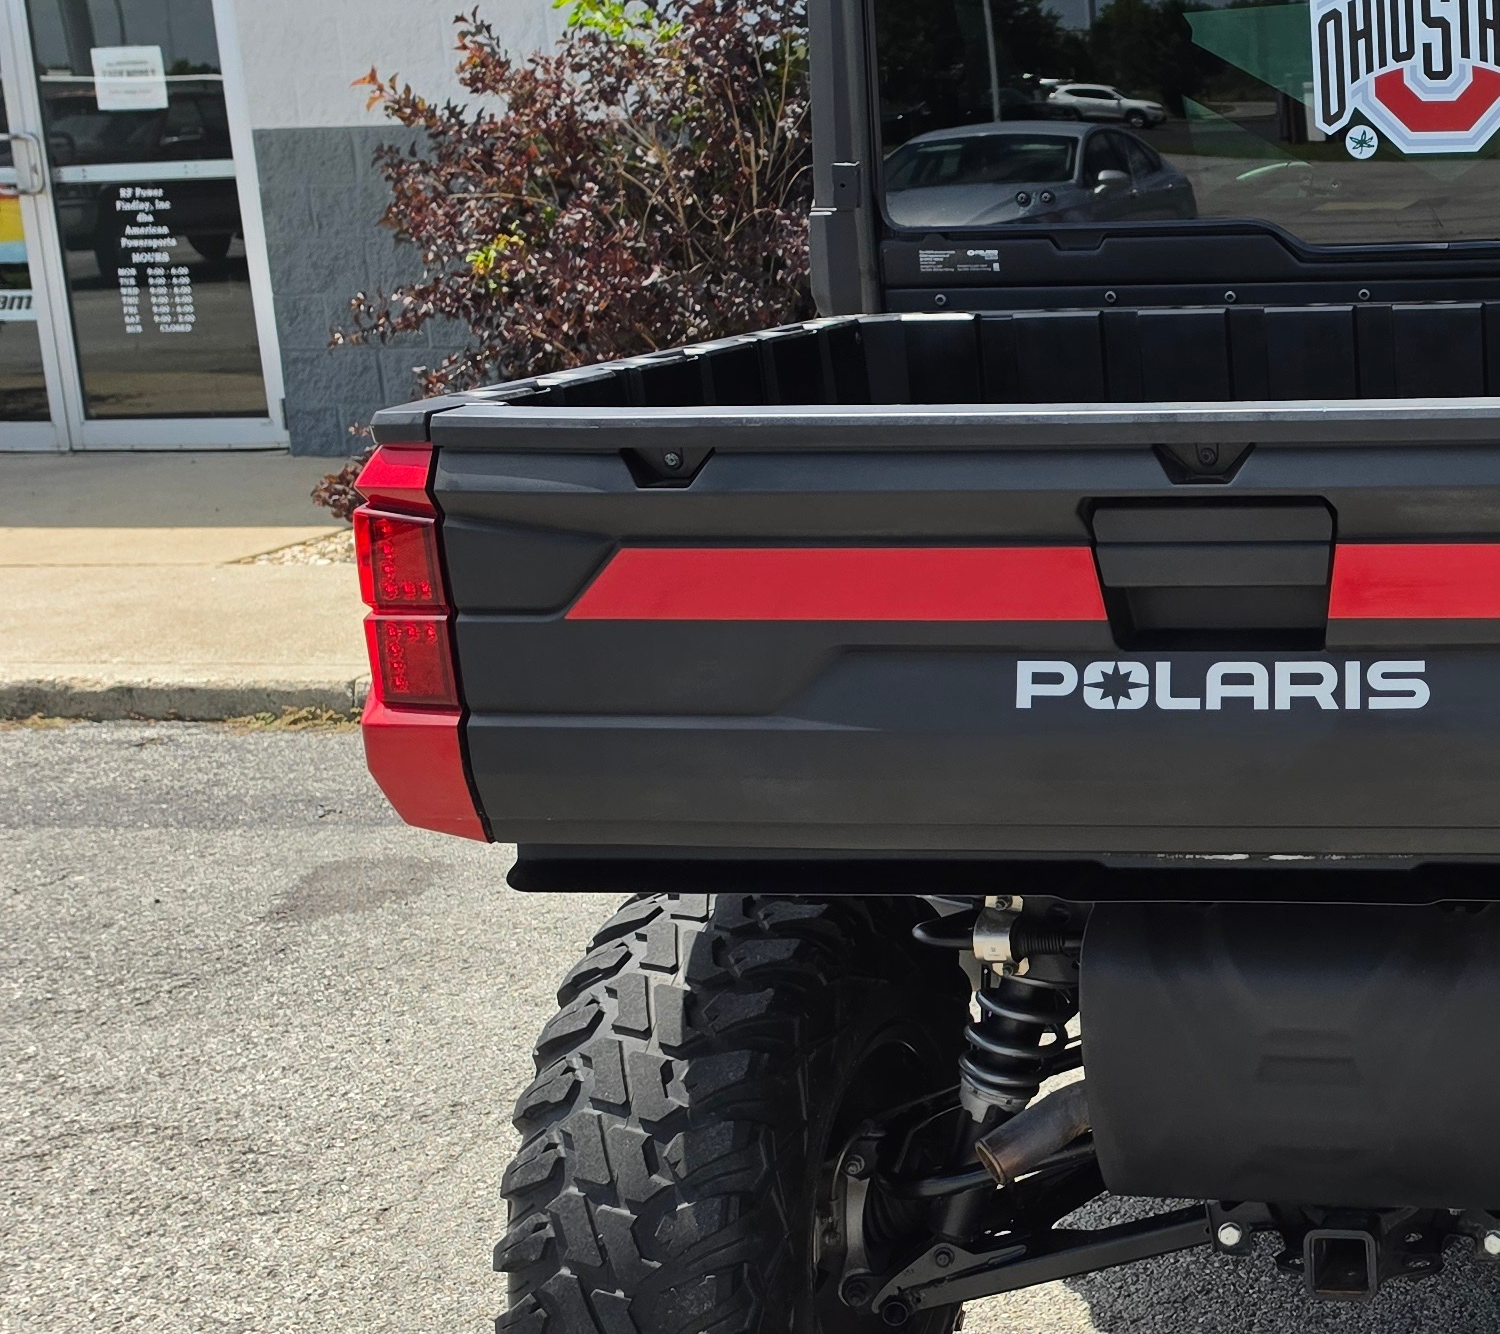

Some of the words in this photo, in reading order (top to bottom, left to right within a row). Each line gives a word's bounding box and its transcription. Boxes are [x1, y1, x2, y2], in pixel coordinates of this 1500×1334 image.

[125, 223, 170, 235] American
[131, 251, 170, 264] HOURS
[1016, 660, 1431, 710] POLARIS
